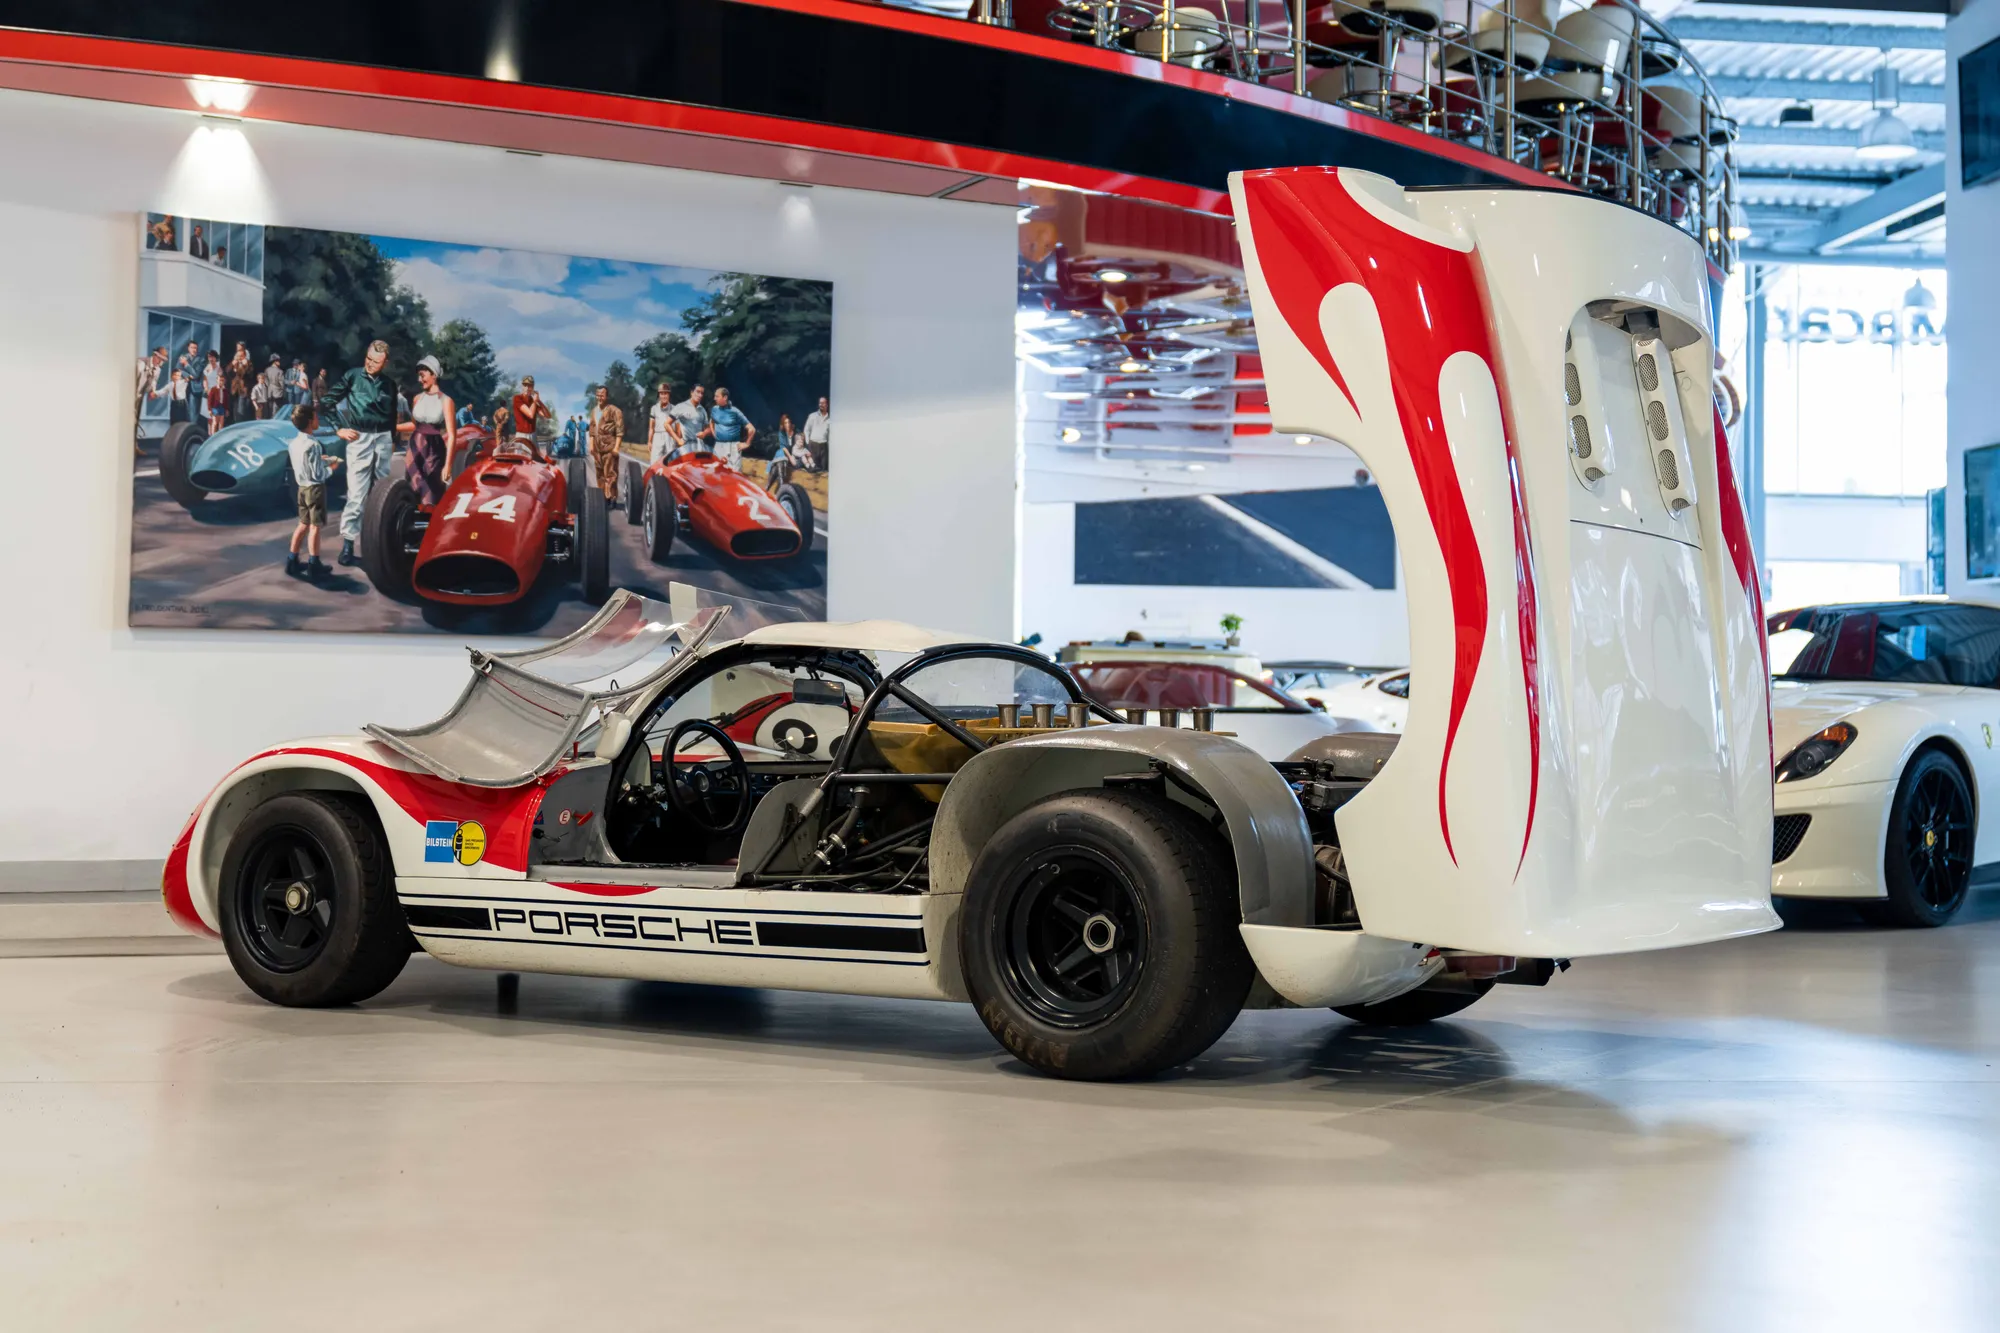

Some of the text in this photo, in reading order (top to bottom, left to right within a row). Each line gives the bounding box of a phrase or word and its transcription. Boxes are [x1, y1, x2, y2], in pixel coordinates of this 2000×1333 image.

[227, 443, 264, 469] 18
[443, 492, 517, 523] 14
[737, 495, 772, 520] 2
[426, 837, 453, 847] BILSTEIN
[493, 908, 754, 946] PORSCHE
